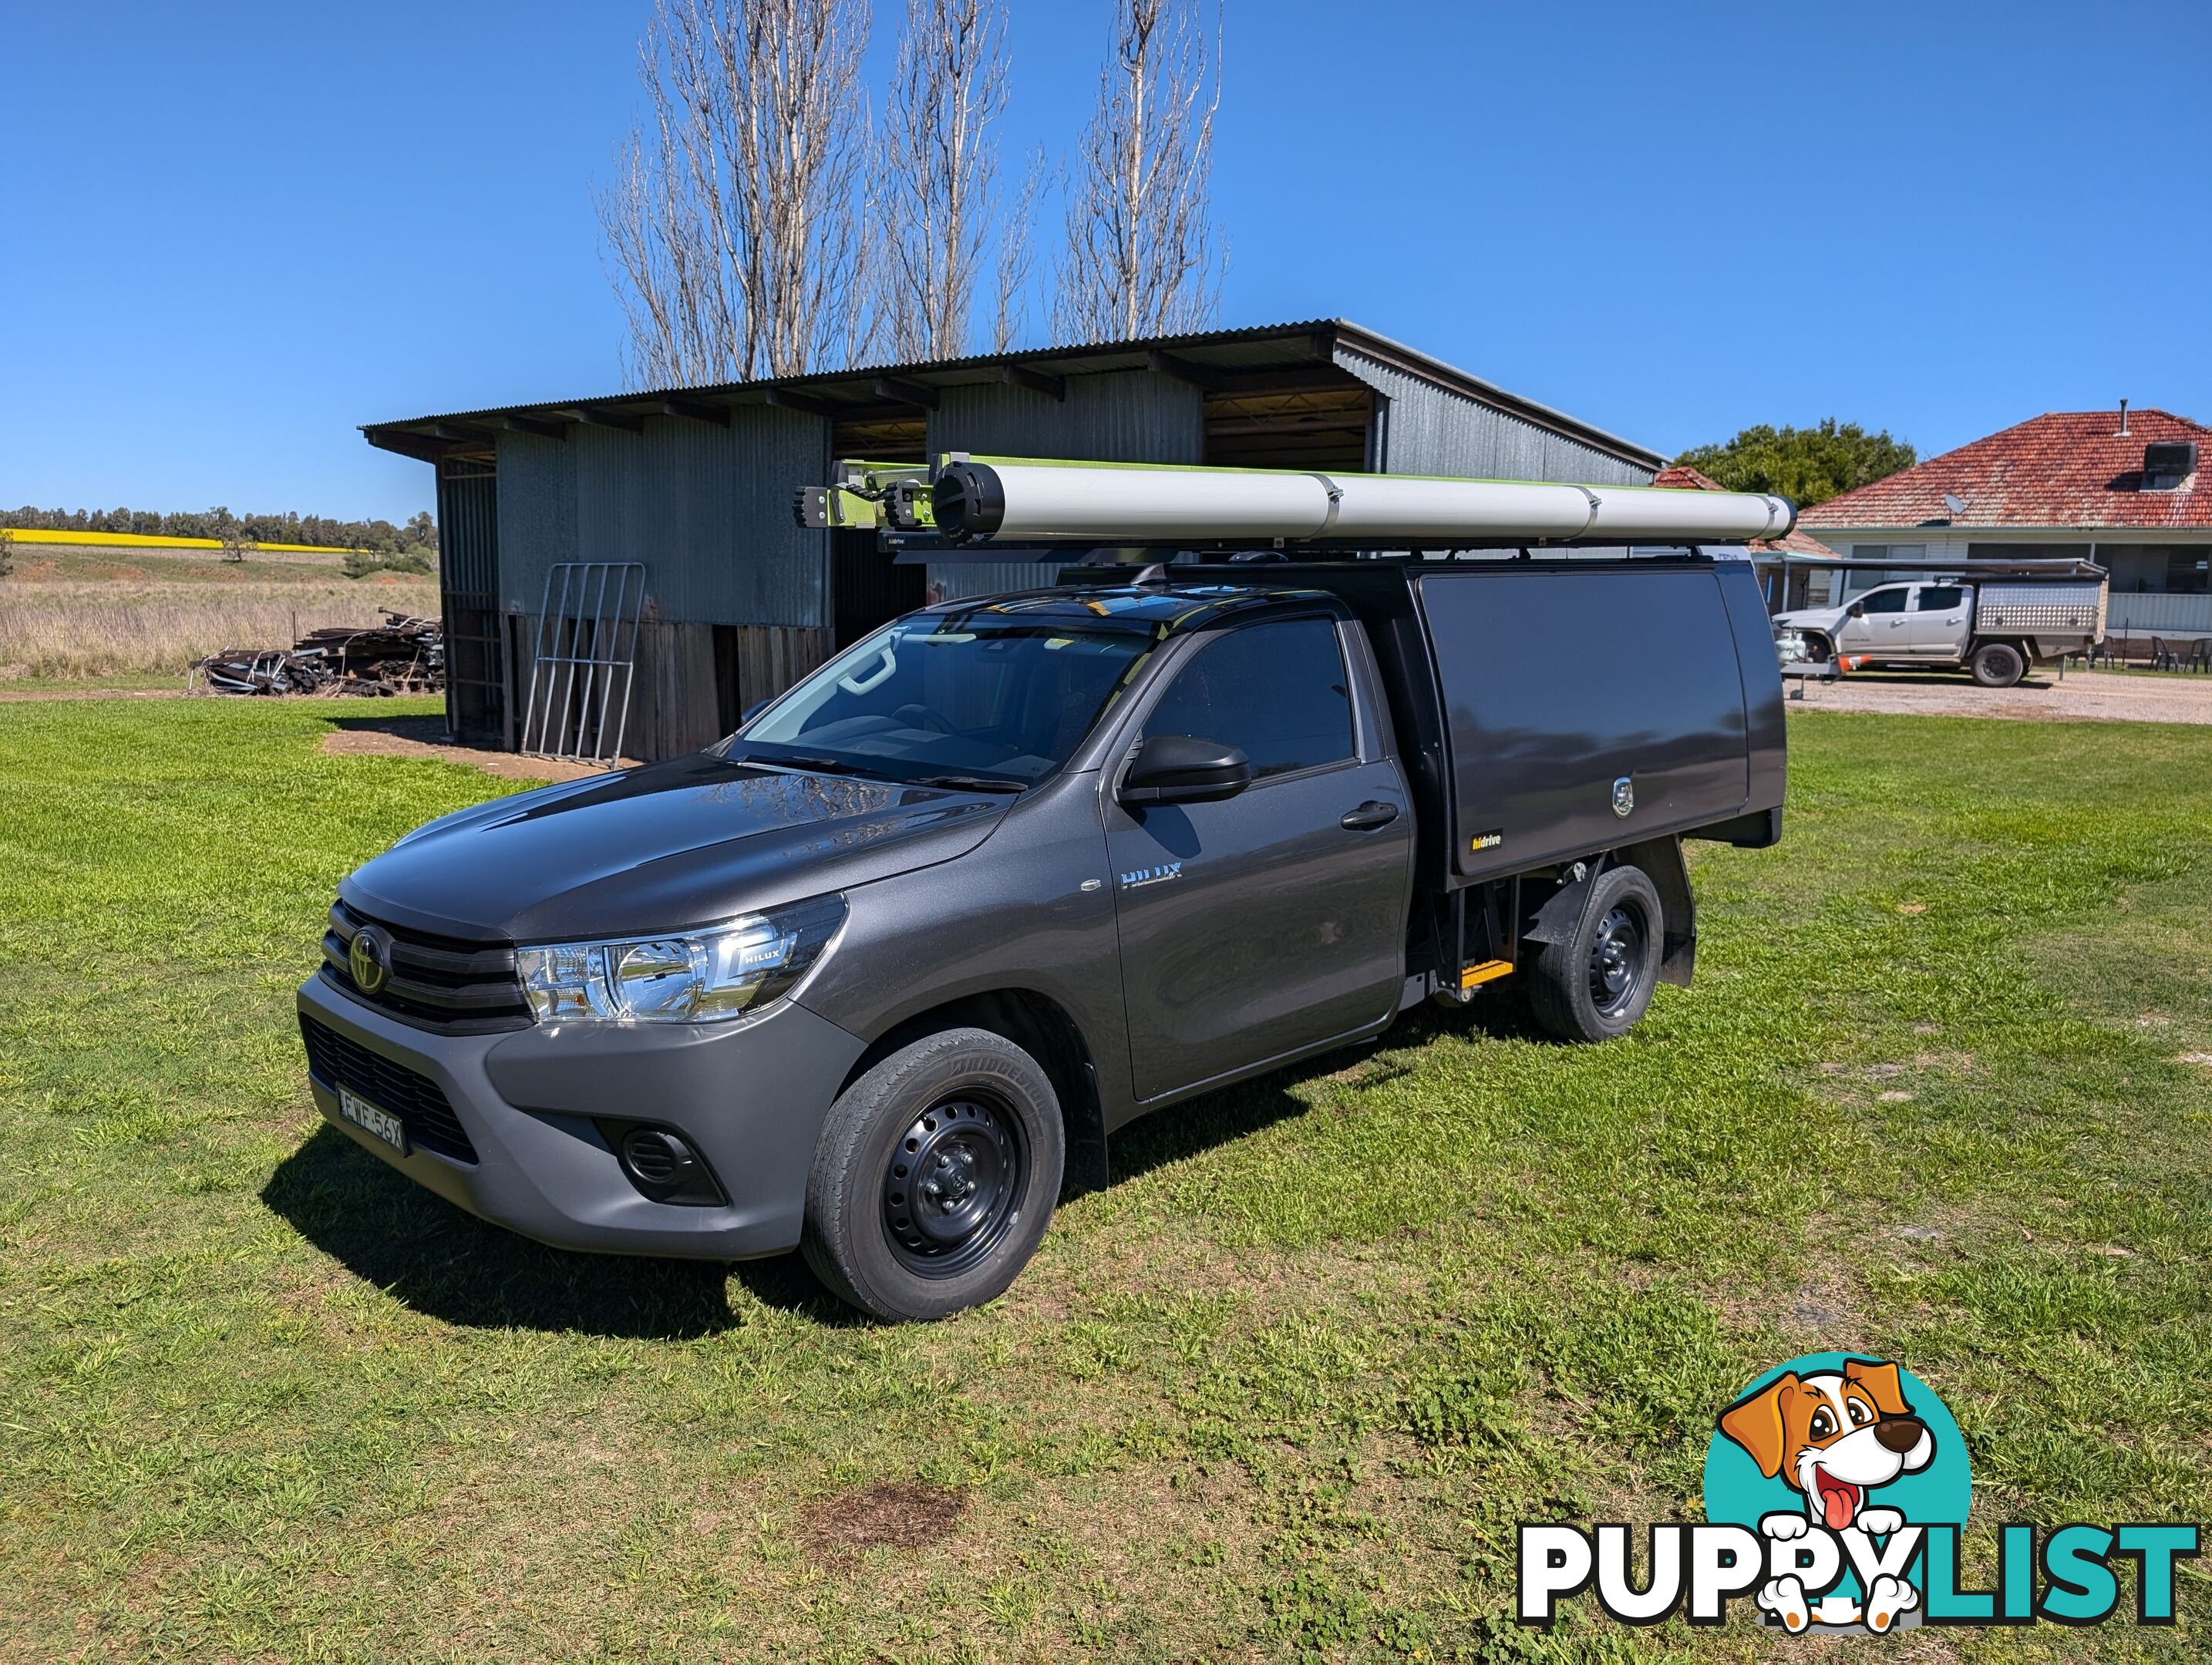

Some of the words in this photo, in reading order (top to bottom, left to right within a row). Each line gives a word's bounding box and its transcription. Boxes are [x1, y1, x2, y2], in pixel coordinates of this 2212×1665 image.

[1473, 834, 1501, 850] hidrive
[1122, 862, 1183, 890] HILUX
[746, 950, 780, 964] HILUX
